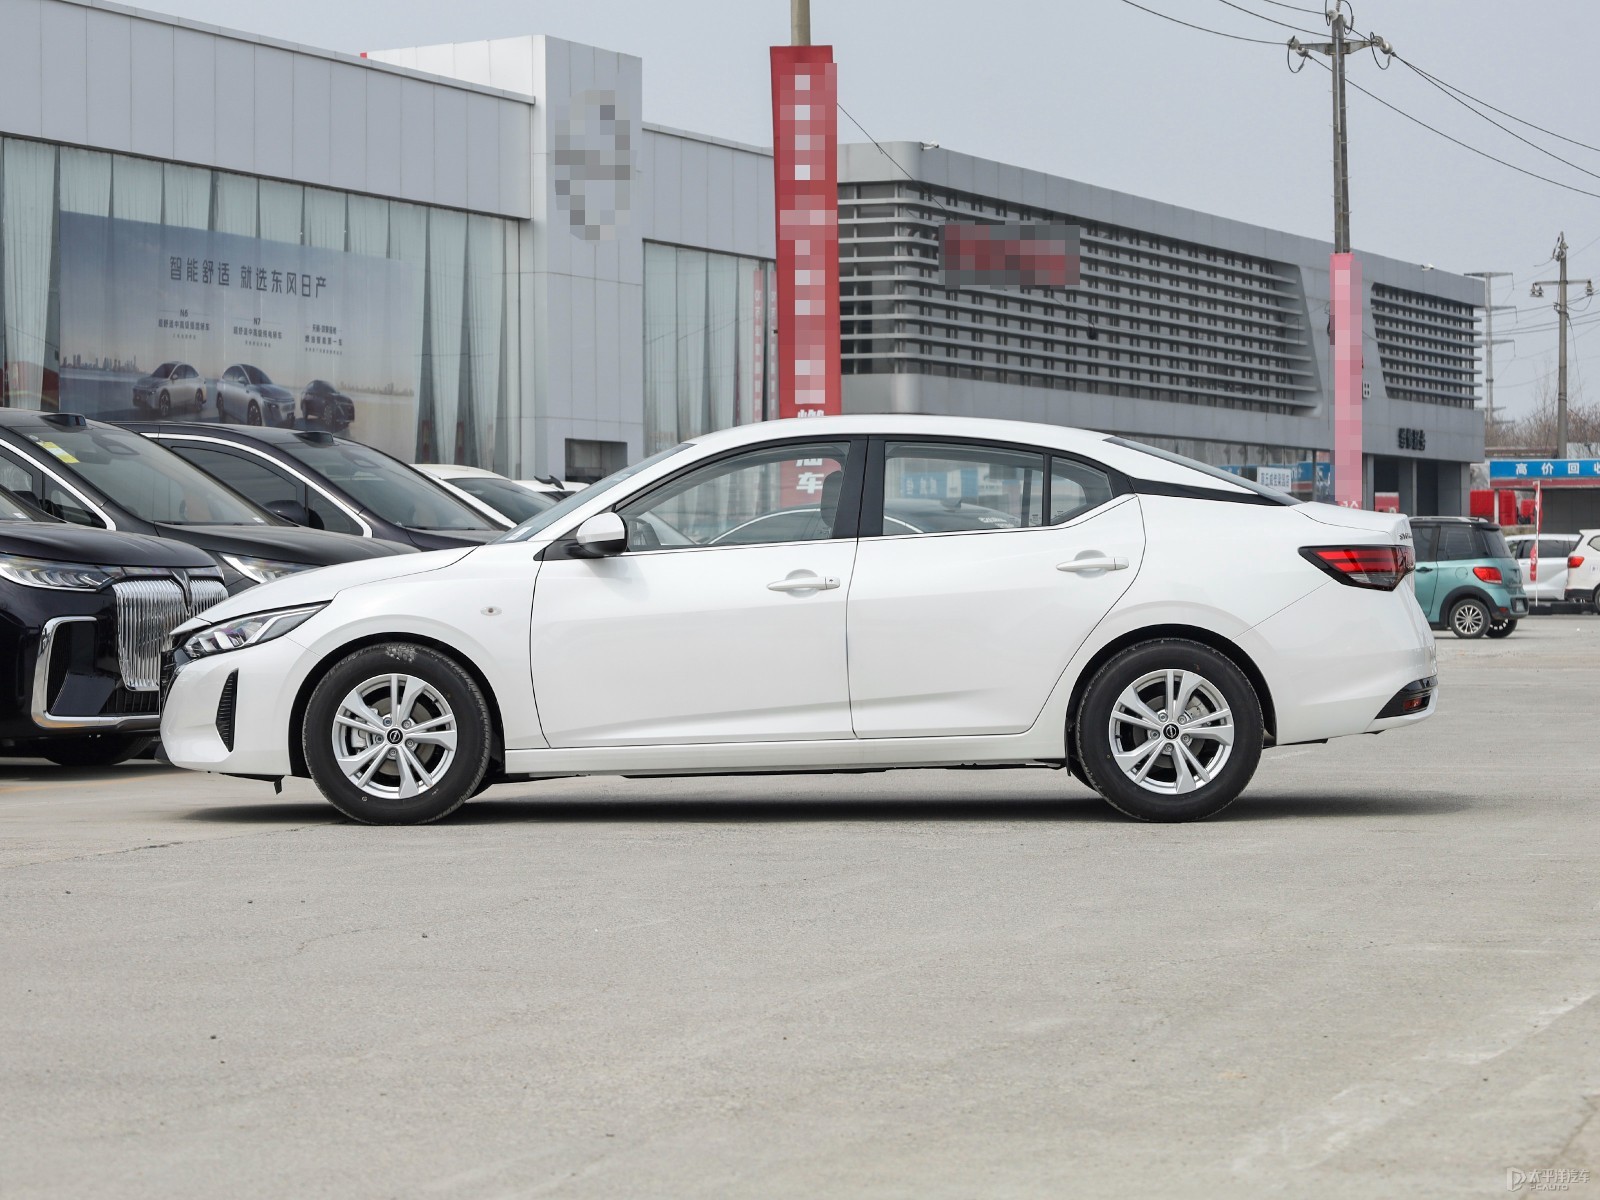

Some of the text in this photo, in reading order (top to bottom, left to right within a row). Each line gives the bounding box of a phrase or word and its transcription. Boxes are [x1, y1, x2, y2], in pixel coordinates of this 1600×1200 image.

[169, 255, 327, 299] 智能舒适 就选东风日产
[253, 317, 261, 326] N7
